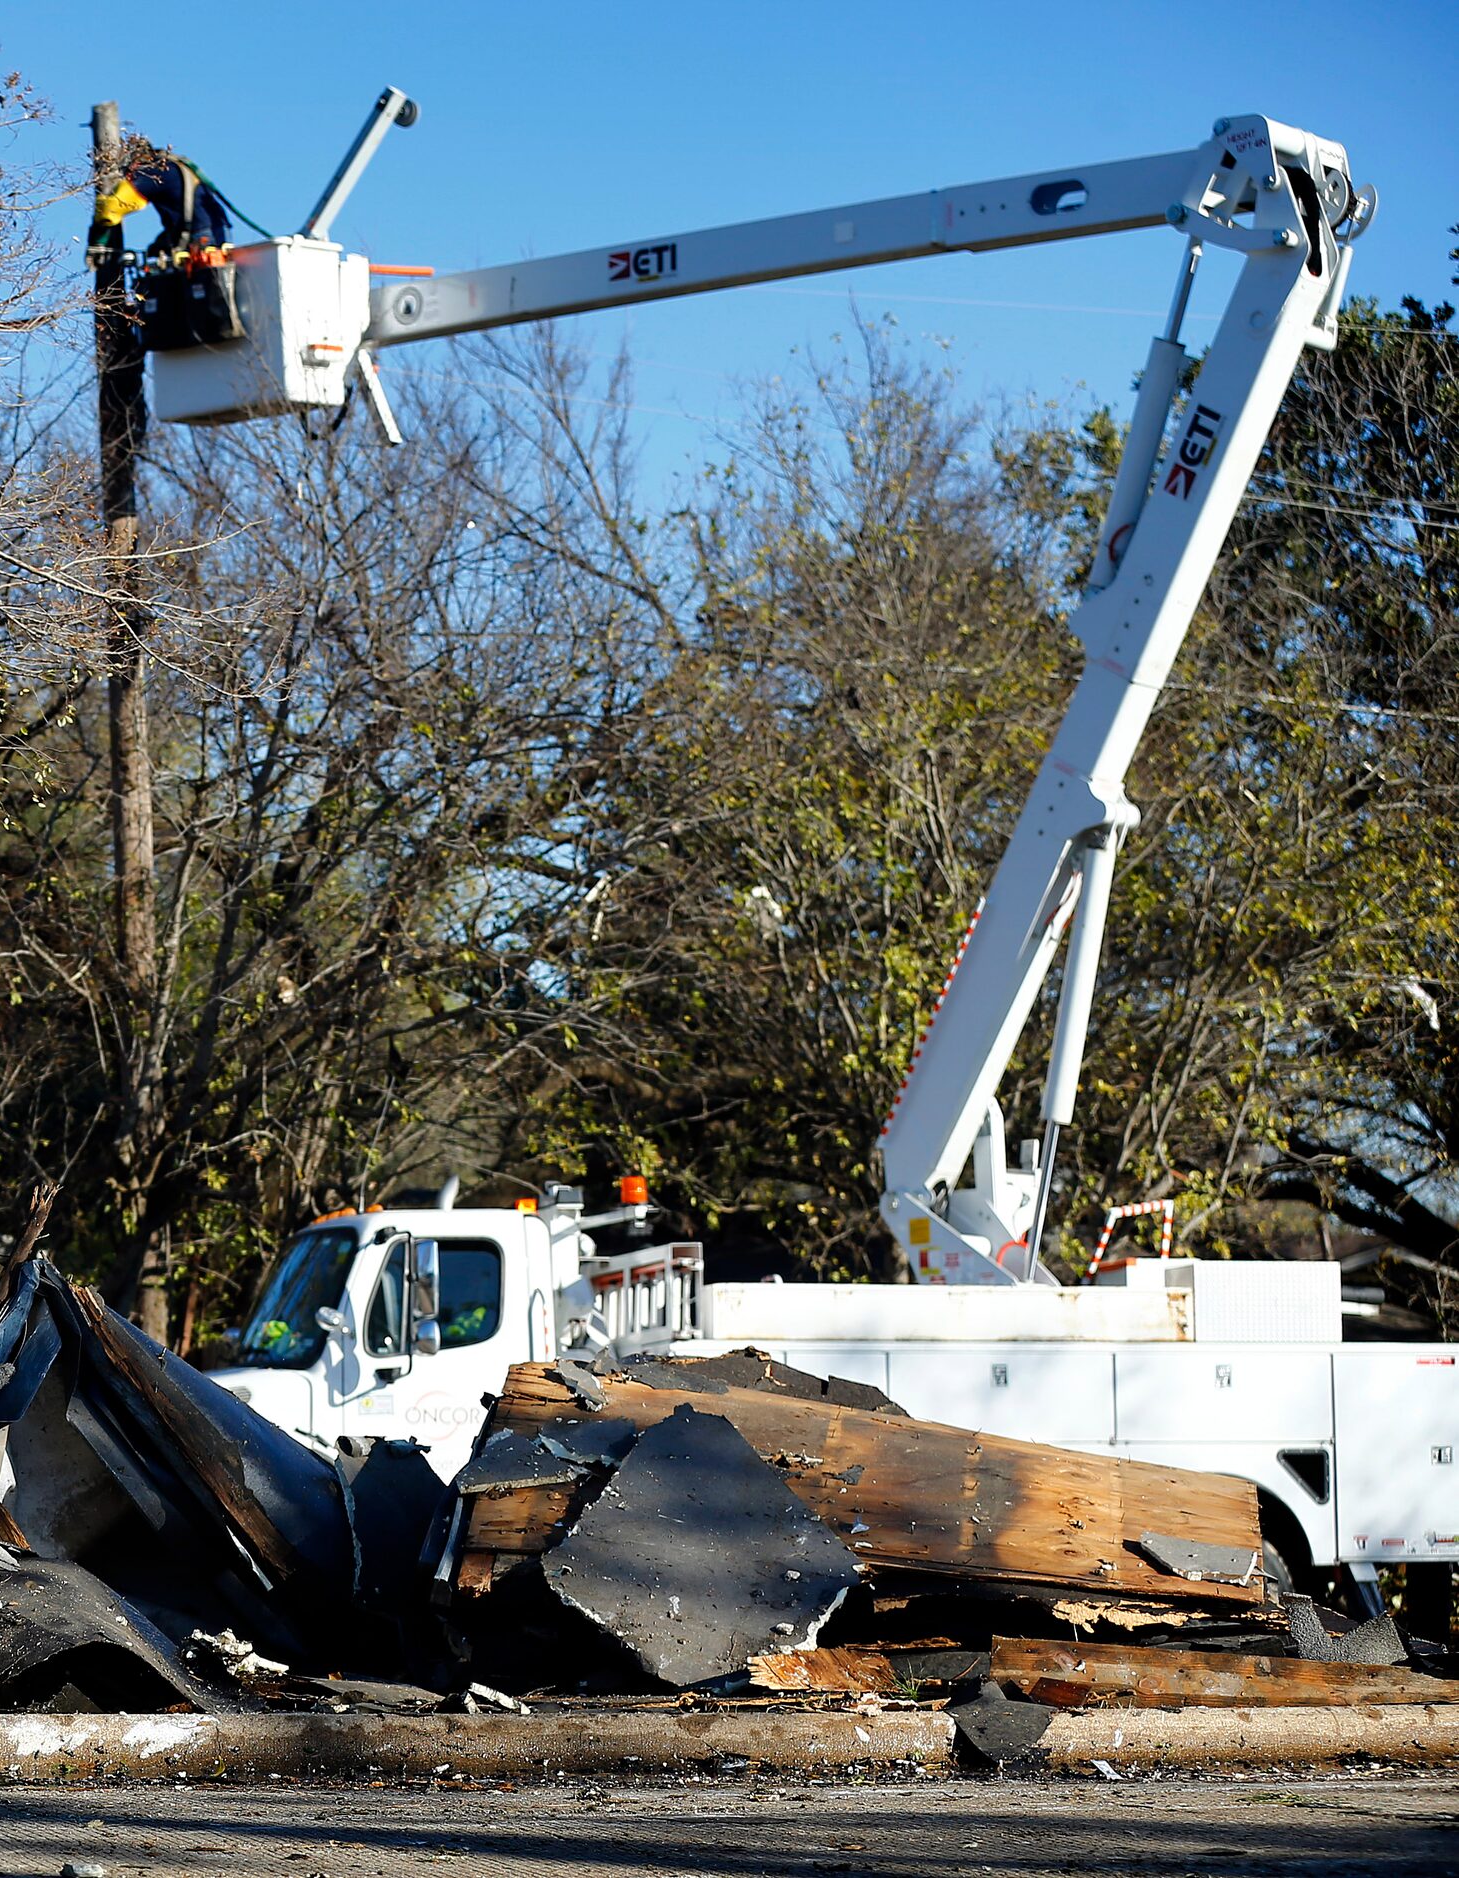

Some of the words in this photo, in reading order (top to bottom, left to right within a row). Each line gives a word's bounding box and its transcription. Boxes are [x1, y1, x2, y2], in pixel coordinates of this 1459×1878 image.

[633, 243, 677, 276] ETI
[1179, 404, 1222, 468] ETI
[405, 1406, 480, 1425] ONCOR
